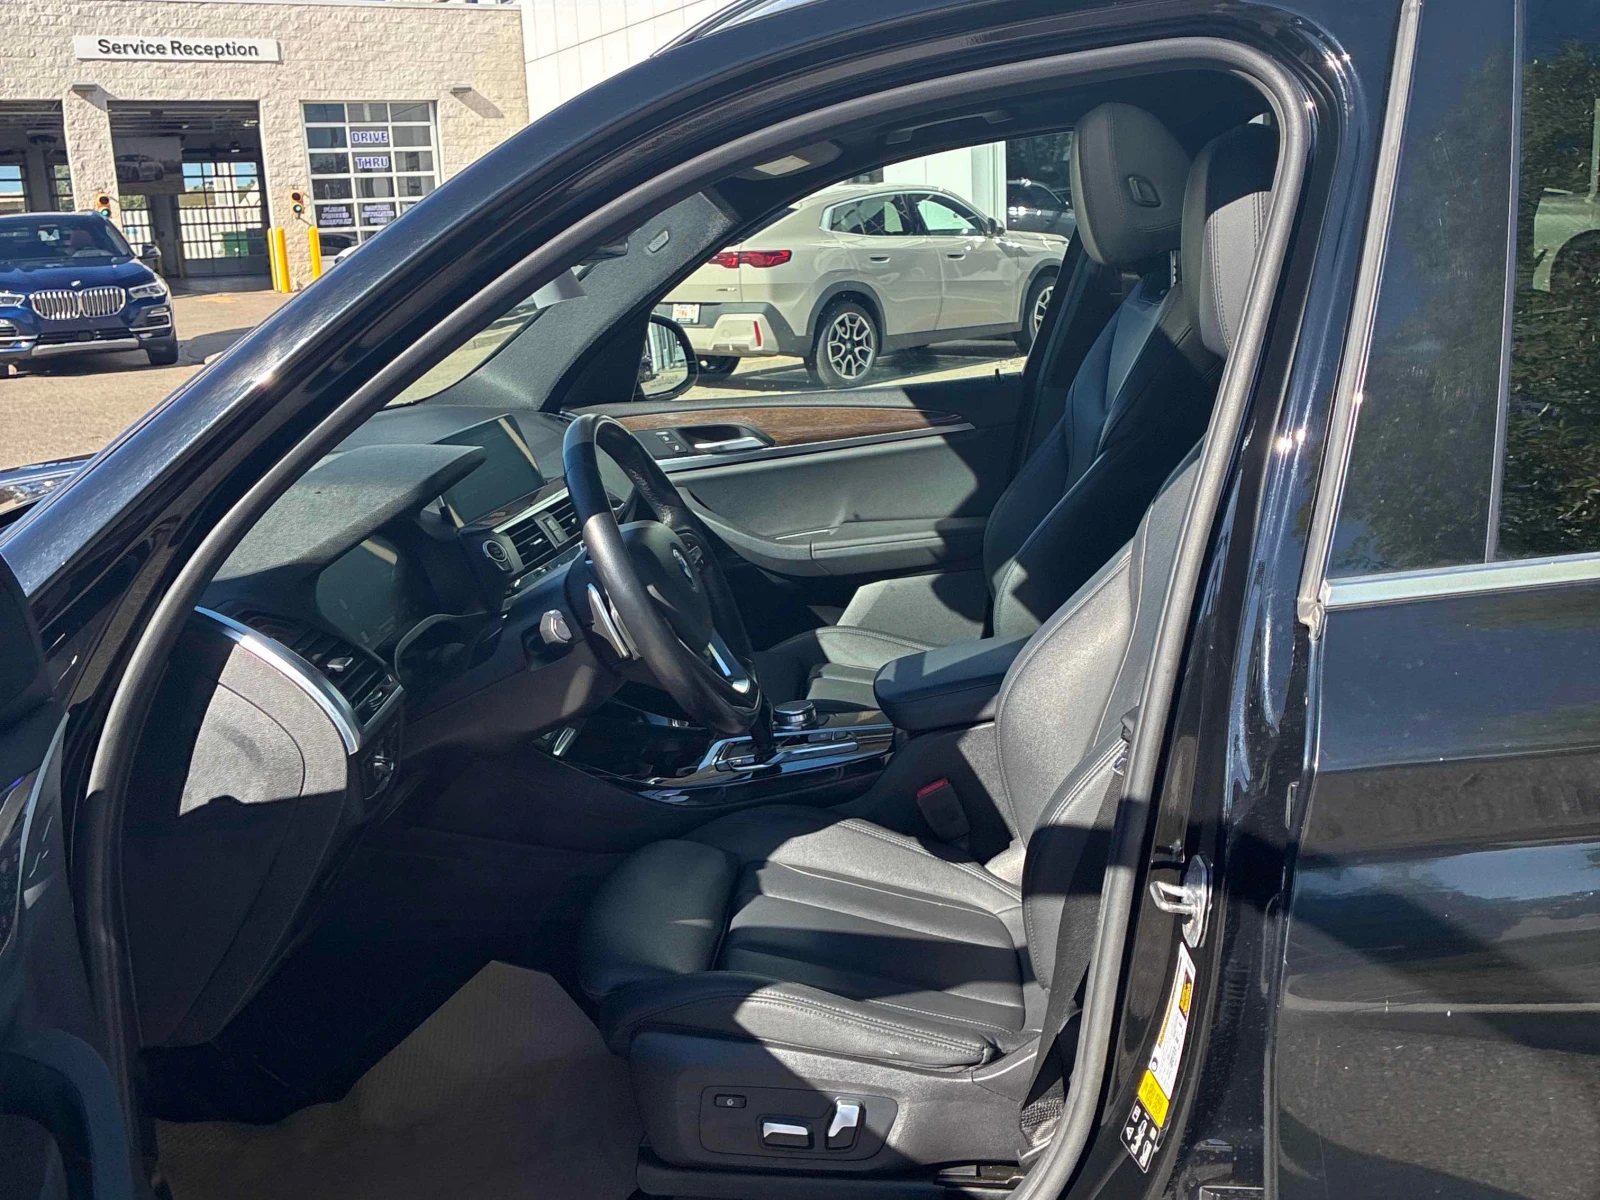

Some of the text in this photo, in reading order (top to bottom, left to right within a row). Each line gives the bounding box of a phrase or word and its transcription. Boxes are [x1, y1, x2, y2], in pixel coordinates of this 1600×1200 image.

[97, 38, 259, 59] Service Reception
[351, 131, 388, 144] DRIVE
[355, 156, 389, 169] THRU
